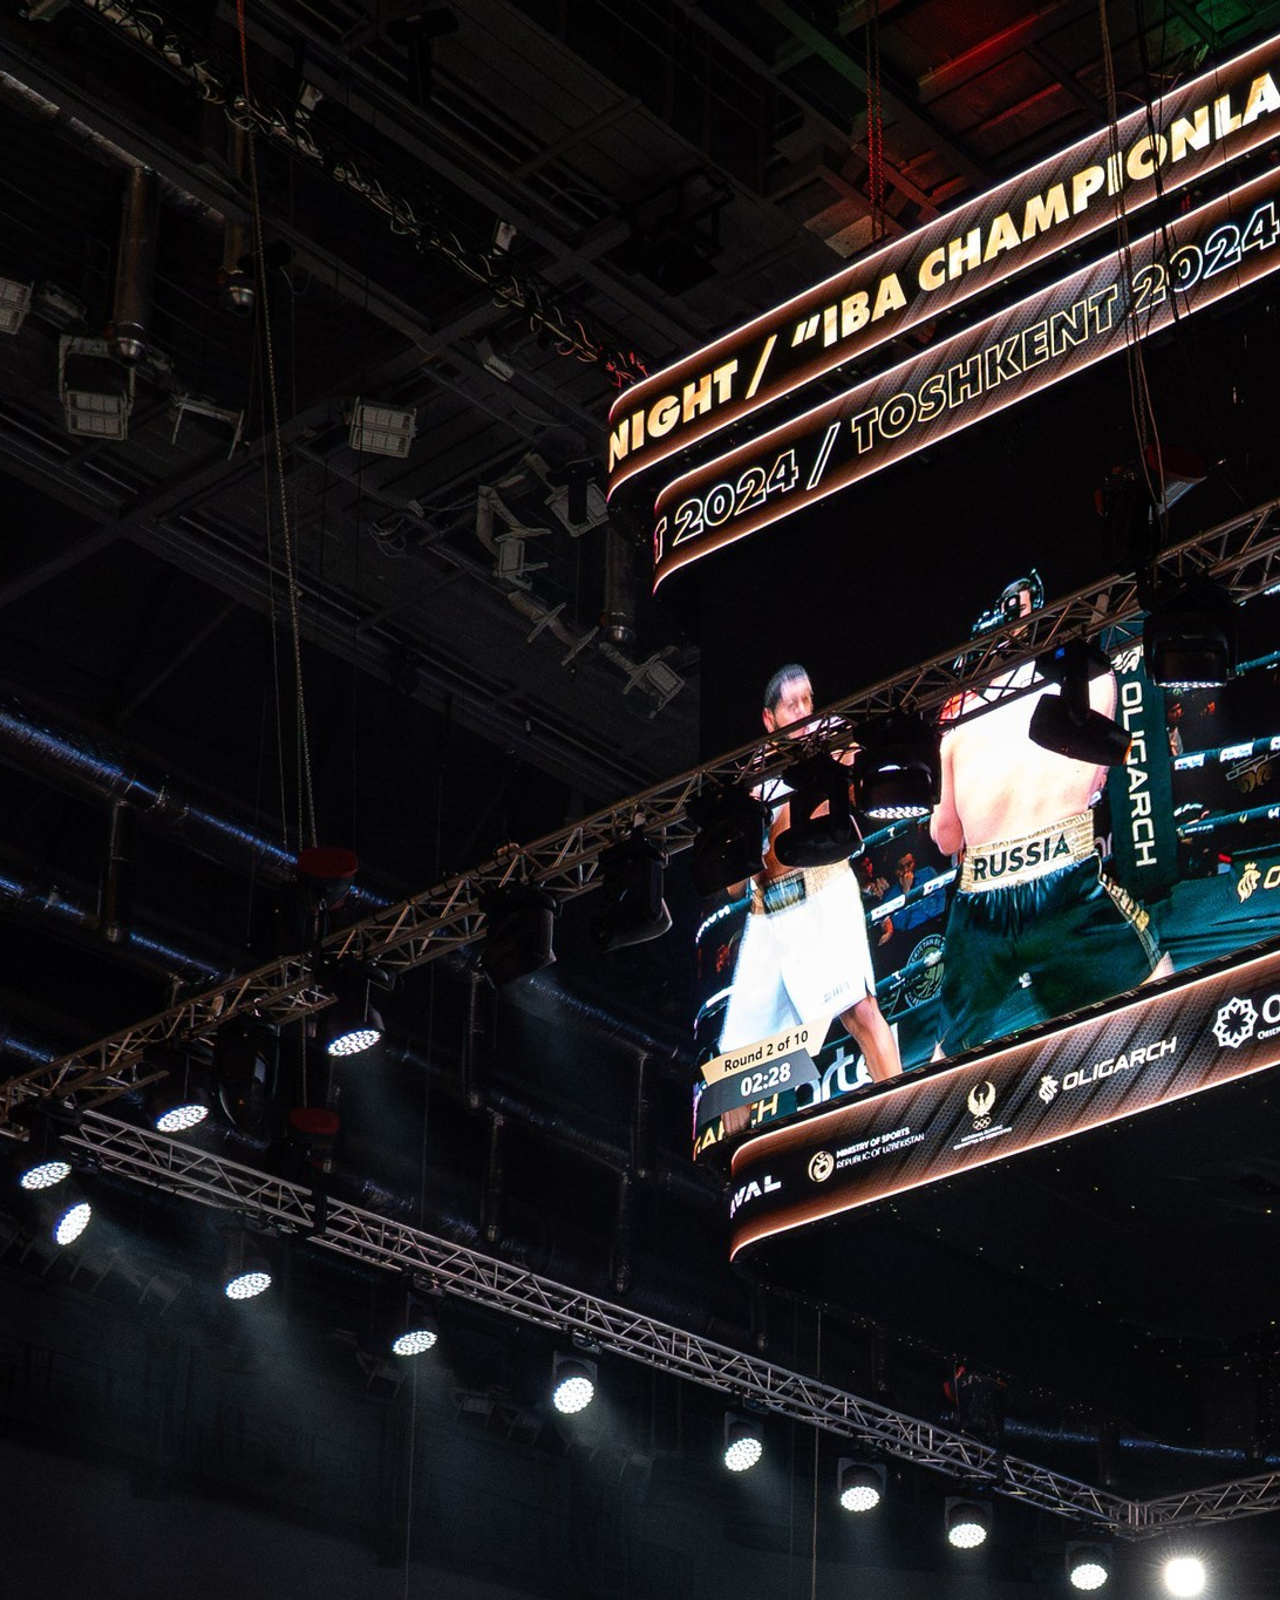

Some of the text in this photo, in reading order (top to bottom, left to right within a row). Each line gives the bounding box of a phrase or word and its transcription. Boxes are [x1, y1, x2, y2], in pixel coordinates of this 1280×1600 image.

[672, 448, 800, 546] 2024
[851, 285, 1119, 456] TOSHKENT
[1132, 200, 1280, 316] 2024
[608, 358, 738, 473] NIGHT
[1121, 680, 1158, 868] OLIGARCH
[972, 832, 1072, 882] RUSSIA
[723, 1029, 809, 1073] Round 2 of 10
[1062, 1036, 1178, 1092] OLIGARCH
[740, 1062, 791, 1098] 02:28
[870, 1137, 882, 1148] OF
[881, 1126, 911, 1143] SPORTS
